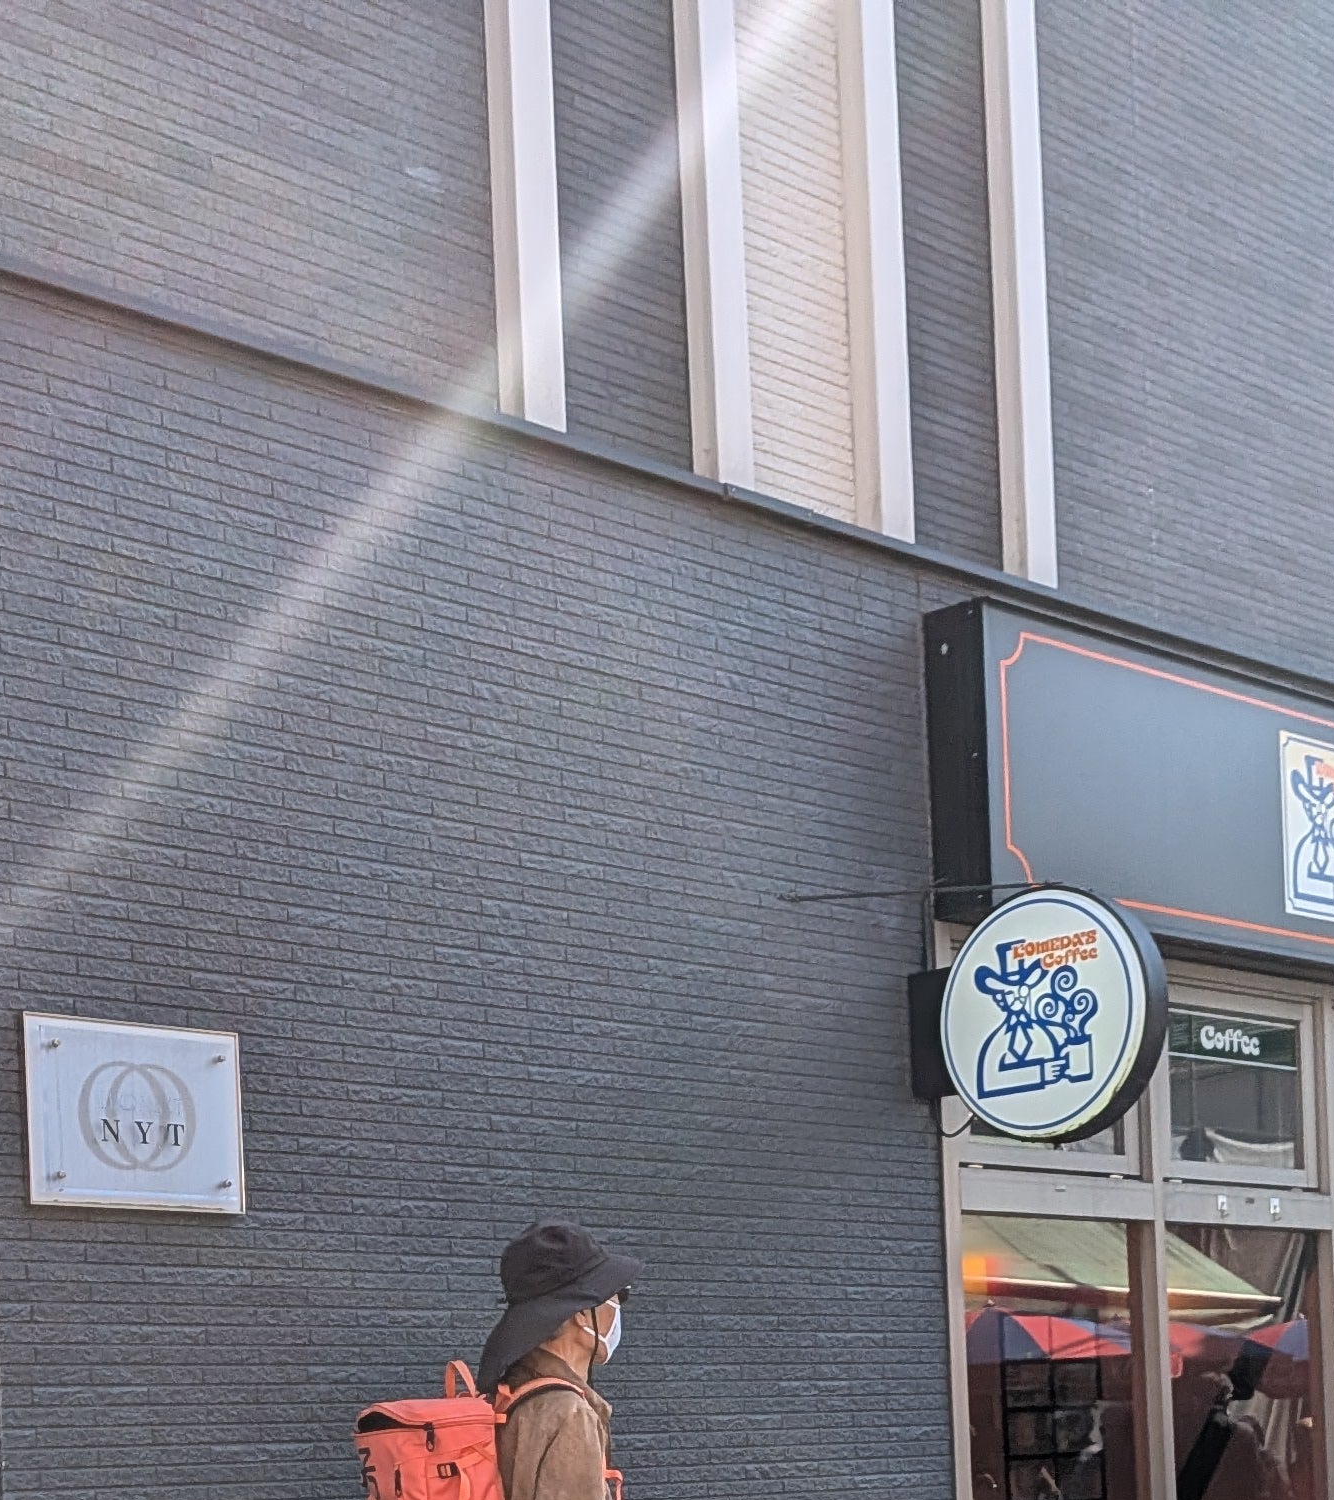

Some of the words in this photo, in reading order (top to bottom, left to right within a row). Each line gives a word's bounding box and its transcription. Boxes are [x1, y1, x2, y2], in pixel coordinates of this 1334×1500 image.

[1013, 929, 1097, 959] KOMEDA'S
[1043, 947, 1098, 968] Coffee
[1200, 1026, 1261, 1057] Coffee
